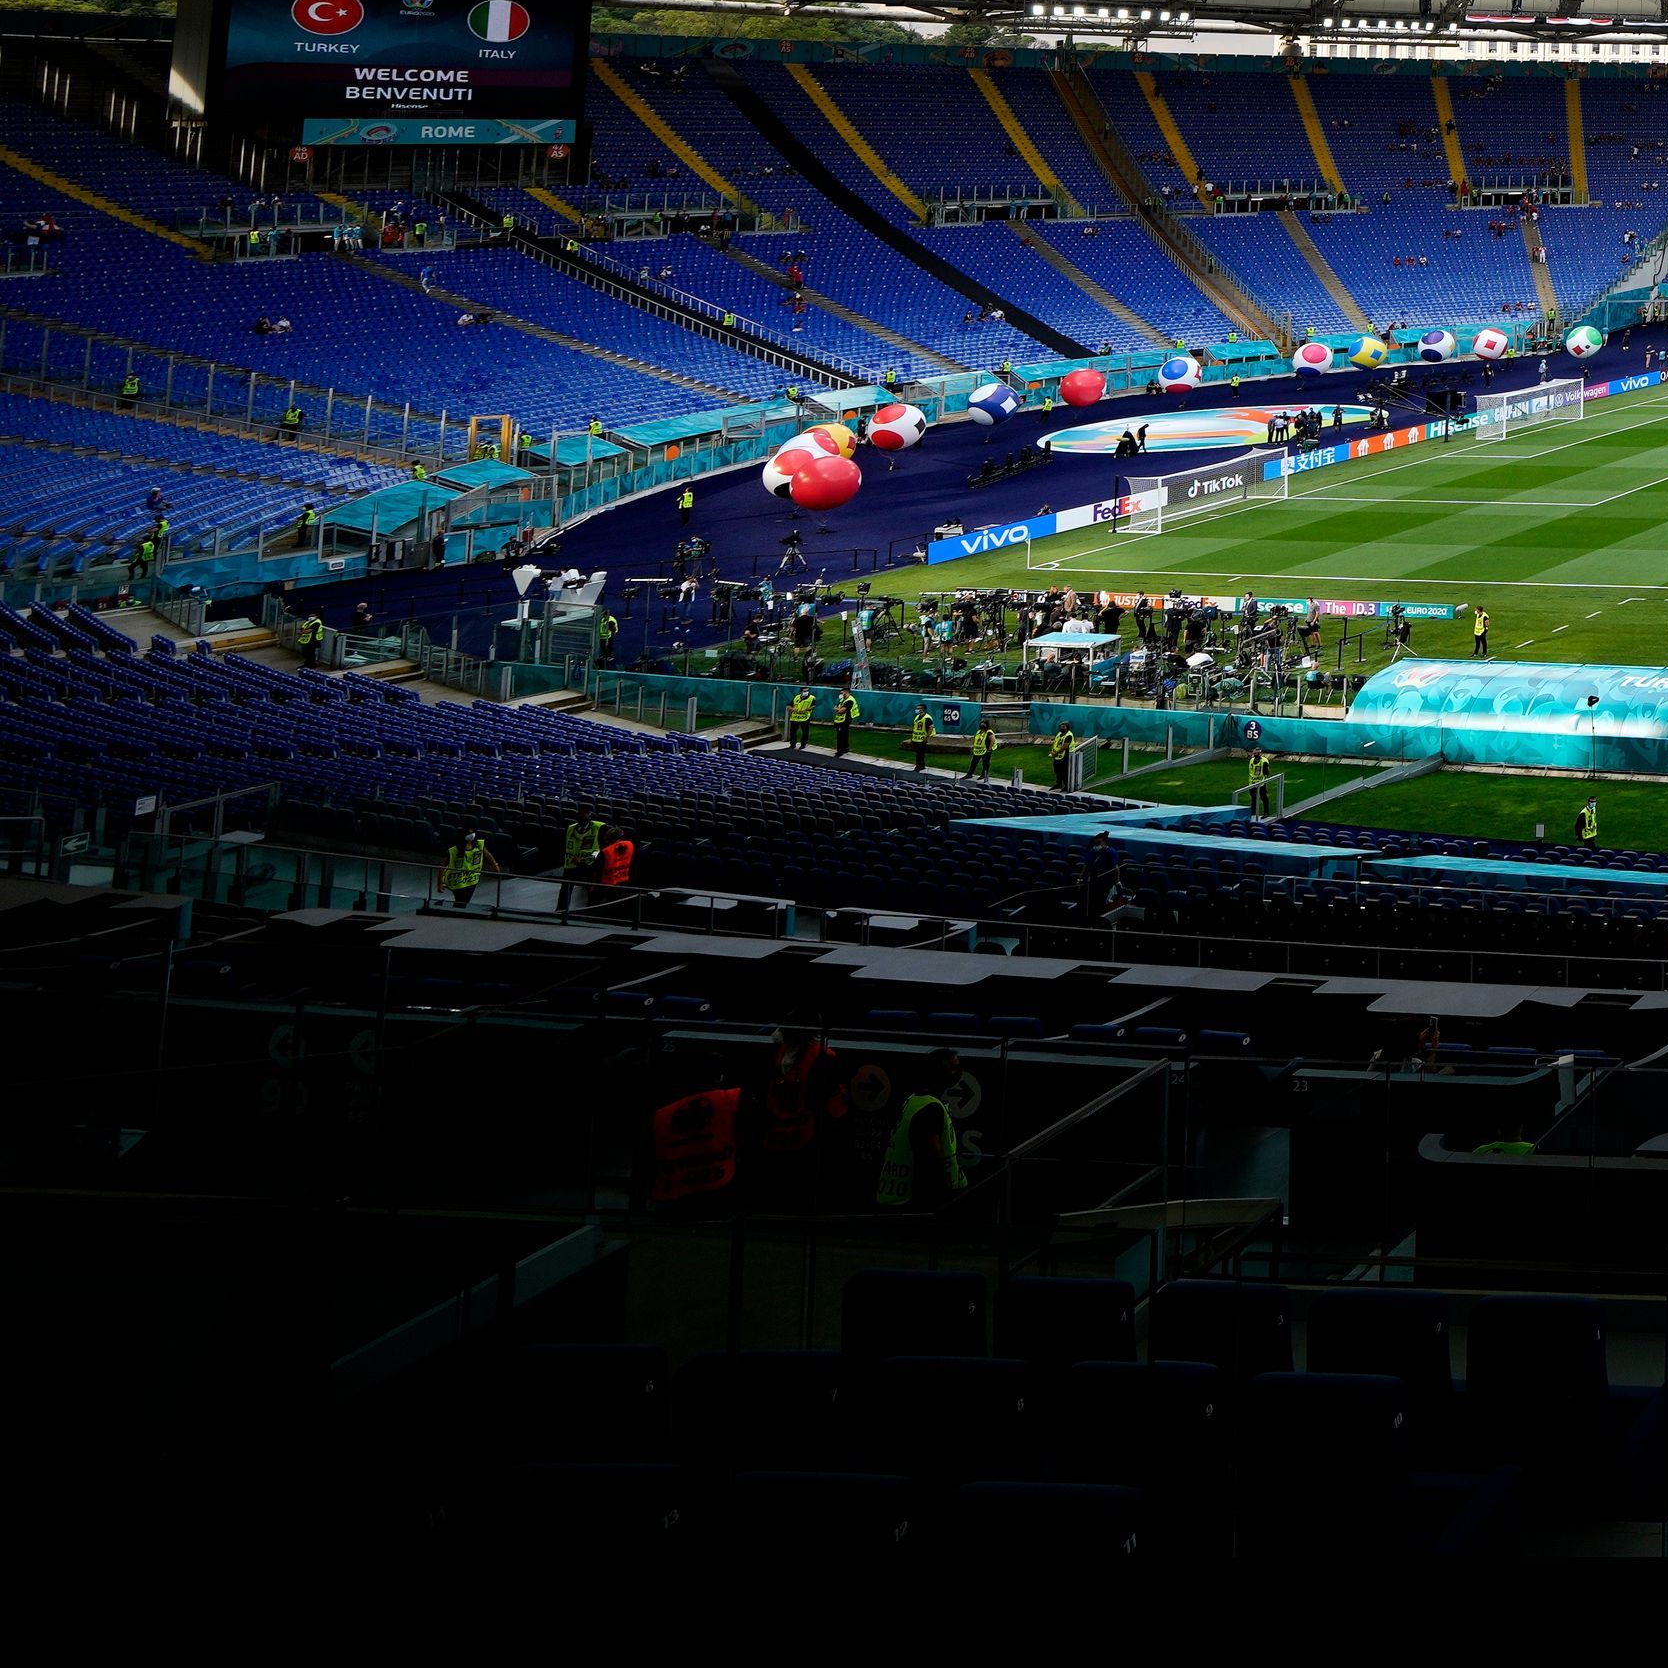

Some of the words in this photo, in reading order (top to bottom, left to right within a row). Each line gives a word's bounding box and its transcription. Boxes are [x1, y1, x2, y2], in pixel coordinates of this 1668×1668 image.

[294, 41, 361, 54] TURKEY
[478, 48, 517, 60] ITALY
[354, 67, 469, 83] WELCOME
[345, 85, 473, 102] BENVENUTI
[420, 125, 476, 139] ROME
[1620, 376, 1648, 391] vivo
[1565, 386, 1606, 403] Volkwagen
[1296, 446, 1336, 471] 支付宝
[1202, 473, 1244, 495] TikTok
[1093, 496, 1142, 522] FedEx
[960, 525, 1029, 554] vivo
[1325, 603, 1346, 614] The
[1352, 604, 1376, 615] ID.3
[1428, 607, 1447, 616] 2020
[1250, 722, 1256, 730] 3
[1246, 730, 1259, 739] BS
[1292, 1080, 1308, 1092] 23
